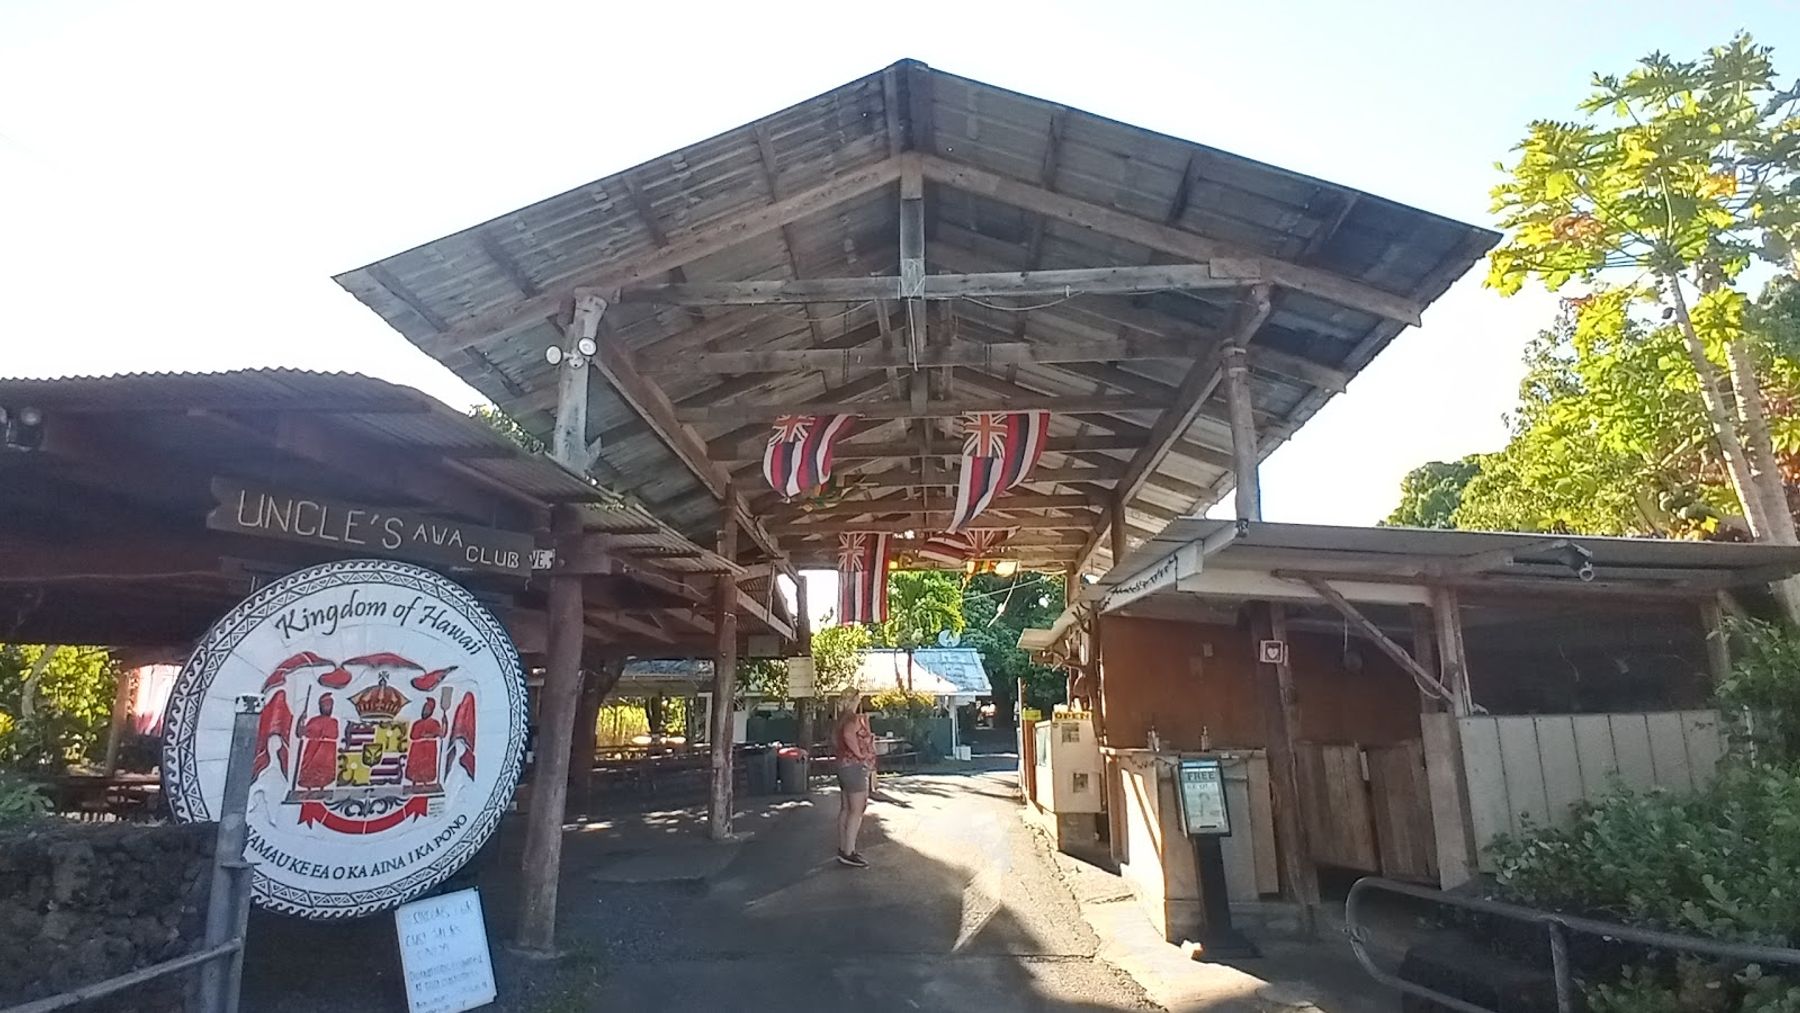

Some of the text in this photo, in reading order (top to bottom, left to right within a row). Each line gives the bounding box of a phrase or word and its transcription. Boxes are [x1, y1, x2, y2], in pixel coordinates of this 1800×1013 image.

[238, 490, 519, 568] UNCLE'S AWA CLUB
[275, 589, 487, 655] Kingdom of Hawaii
[1055, 712, 1090, 720] OPEN
[1187, 771, 1216, 781] FREE
[370, 855, 407, 877] AINA
[415, 841, 435, 861] KA
[433, 813, 468, 848] PONO
